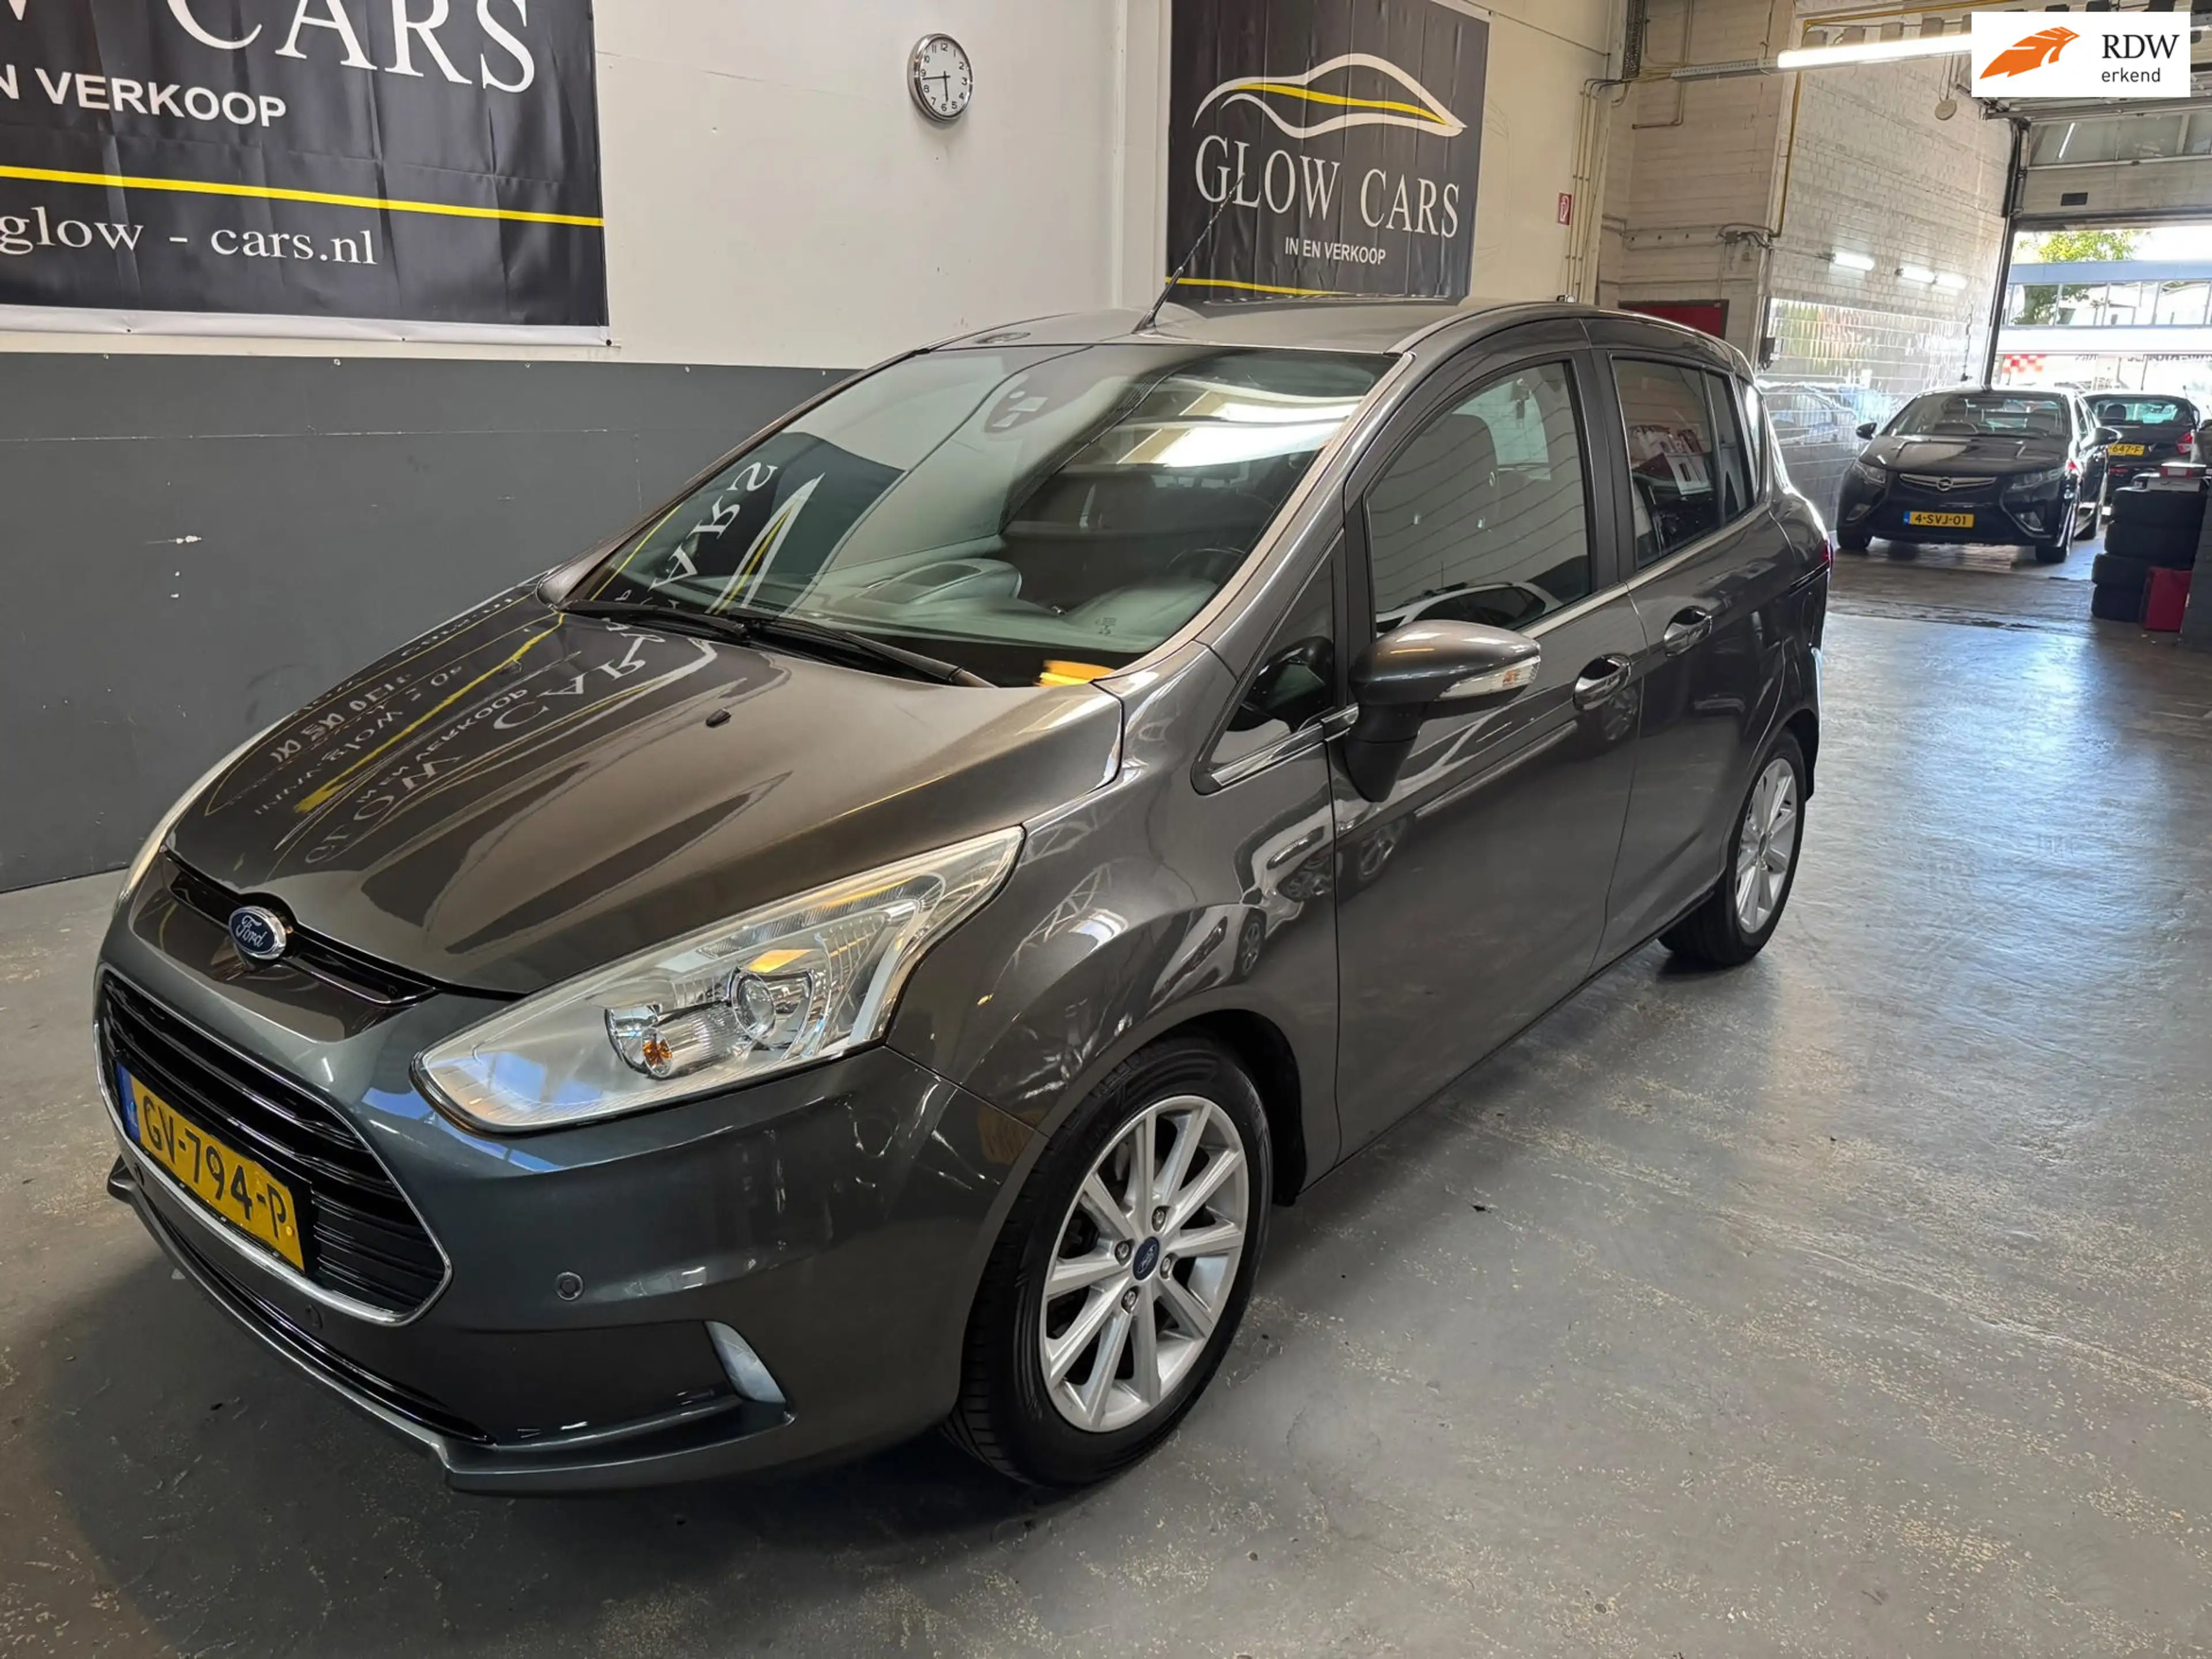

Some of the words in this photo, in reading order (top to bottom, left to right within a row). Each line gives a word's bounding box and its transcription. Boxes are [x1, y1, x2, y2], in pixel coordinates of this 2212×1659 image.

[932, 44, 937, 54] 11
[941, 43, 948, 51] 12
[953, 49, 956, 57] 1
[924, 55, 930, 63] 10
[959, 62, 964, 70] 2
[961, 77, 968, 86] 3
[923, 85, 930, 93] 8
[35, 67, 286, 127] VERKOOP
[931, 97, 936, 105] 7
[941, 103, 947, 111] 6
[952, 101, 957, 109] 5
[1195, 135, 1343, 221] GLOW
[1361, 169, 1460, 238] CARS
[0, 205, 143, 255] glow
[210, 228, 378, 264] cars.nl
[1285, 236, 1299, 256] IN
[1302, 240, 1321, 258] EN
[1324, 242, 1386, 265] VERKOOP
[1915, 514, 1967, 525] 4-SVJ-01
[236, 915, 268, 948] Ford
[143, 1095, 287, 1240] GV-794-P
